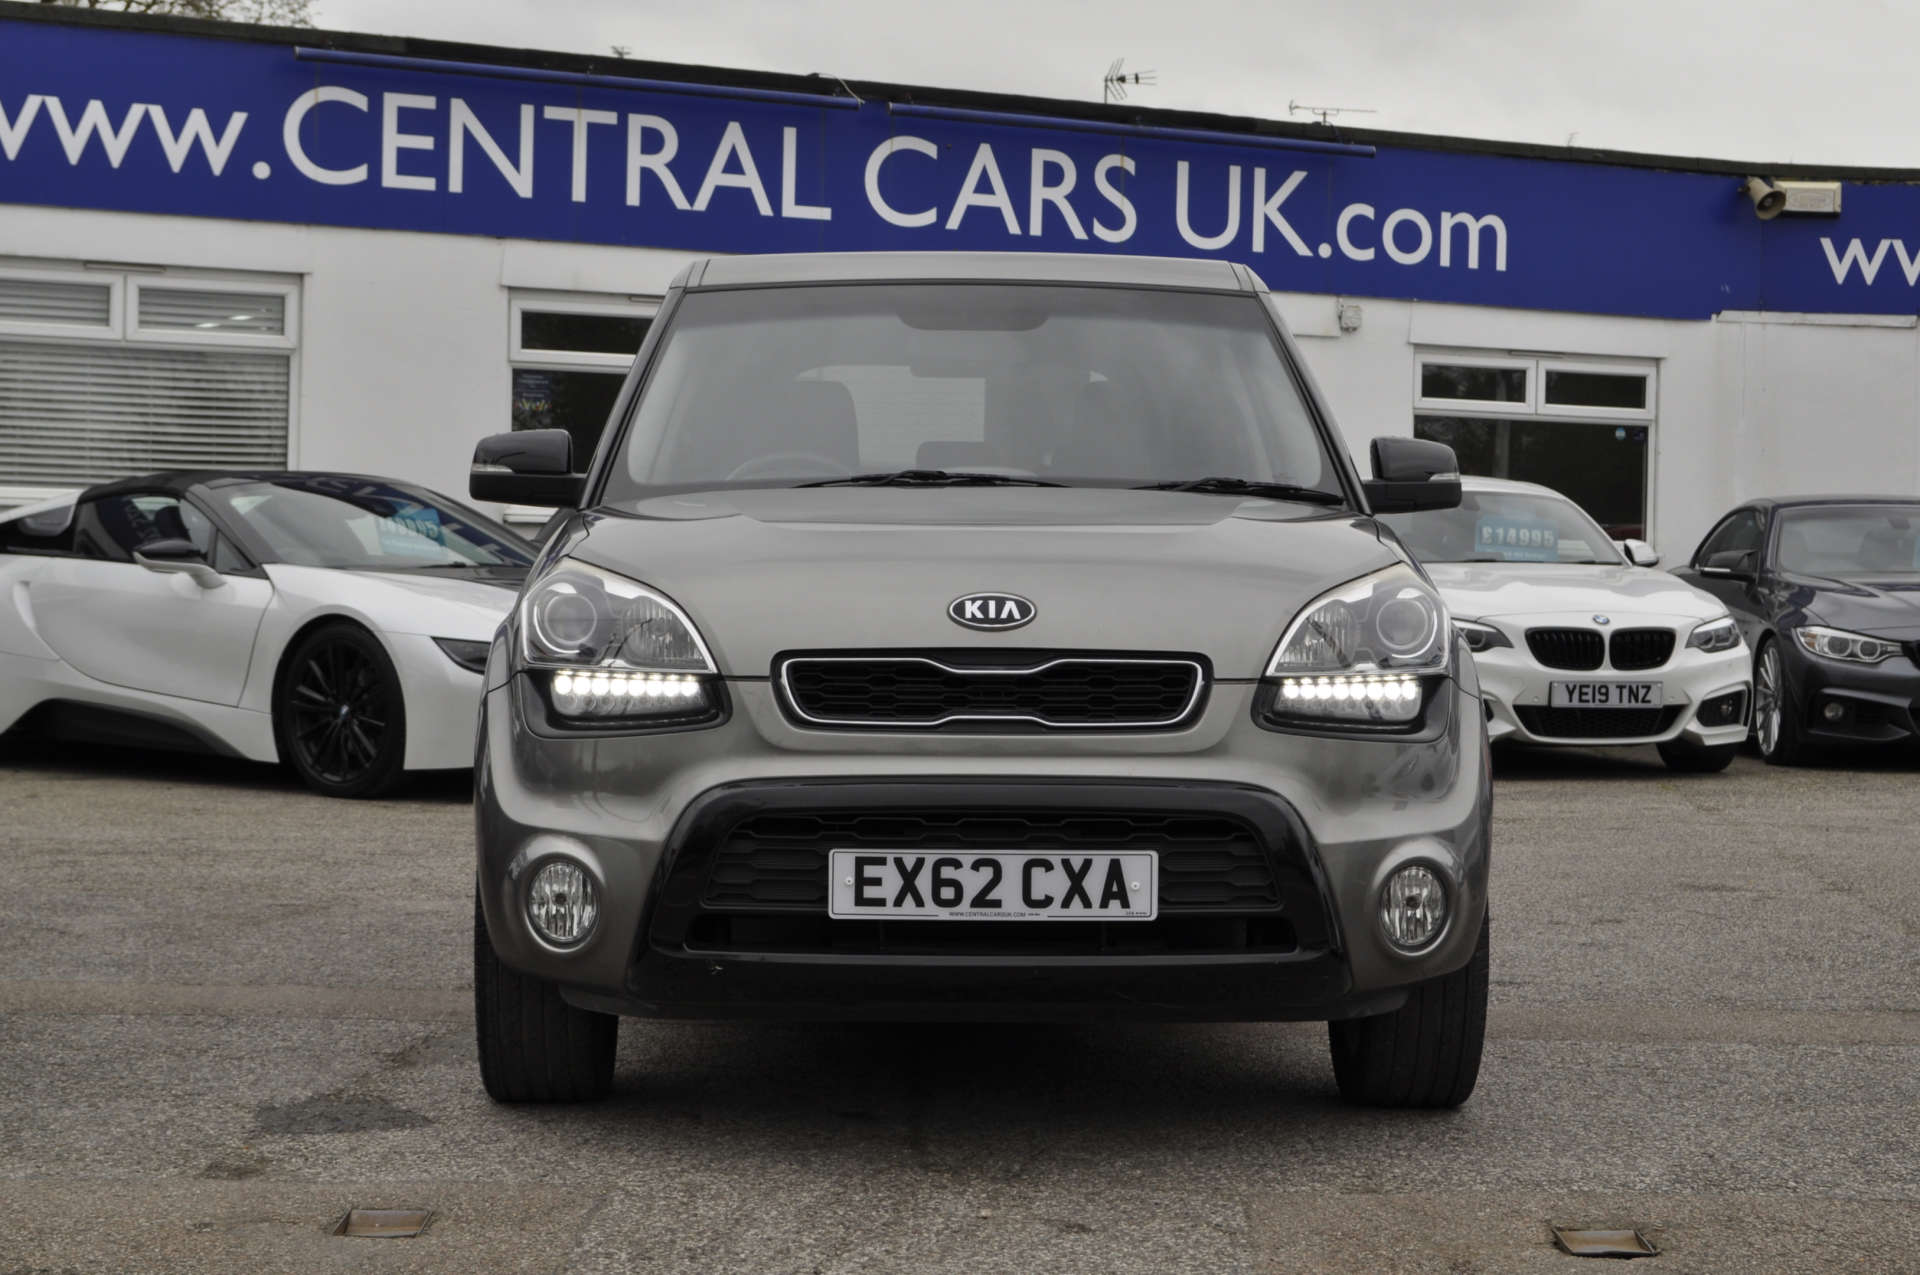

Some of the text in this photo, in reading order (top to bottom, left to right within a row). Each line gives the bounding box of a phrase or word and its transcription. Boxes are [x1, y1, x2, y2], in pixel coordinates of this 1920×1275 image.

[864, 135, 1137, 243] CARS
[1175, 160, 1508, 273] UK.com
[964, 599, 1021, 620] KIA
[1565, 685, 1652, 704] YE19 TNZ
[854, 856, 1131, 909] EX62 CXA
